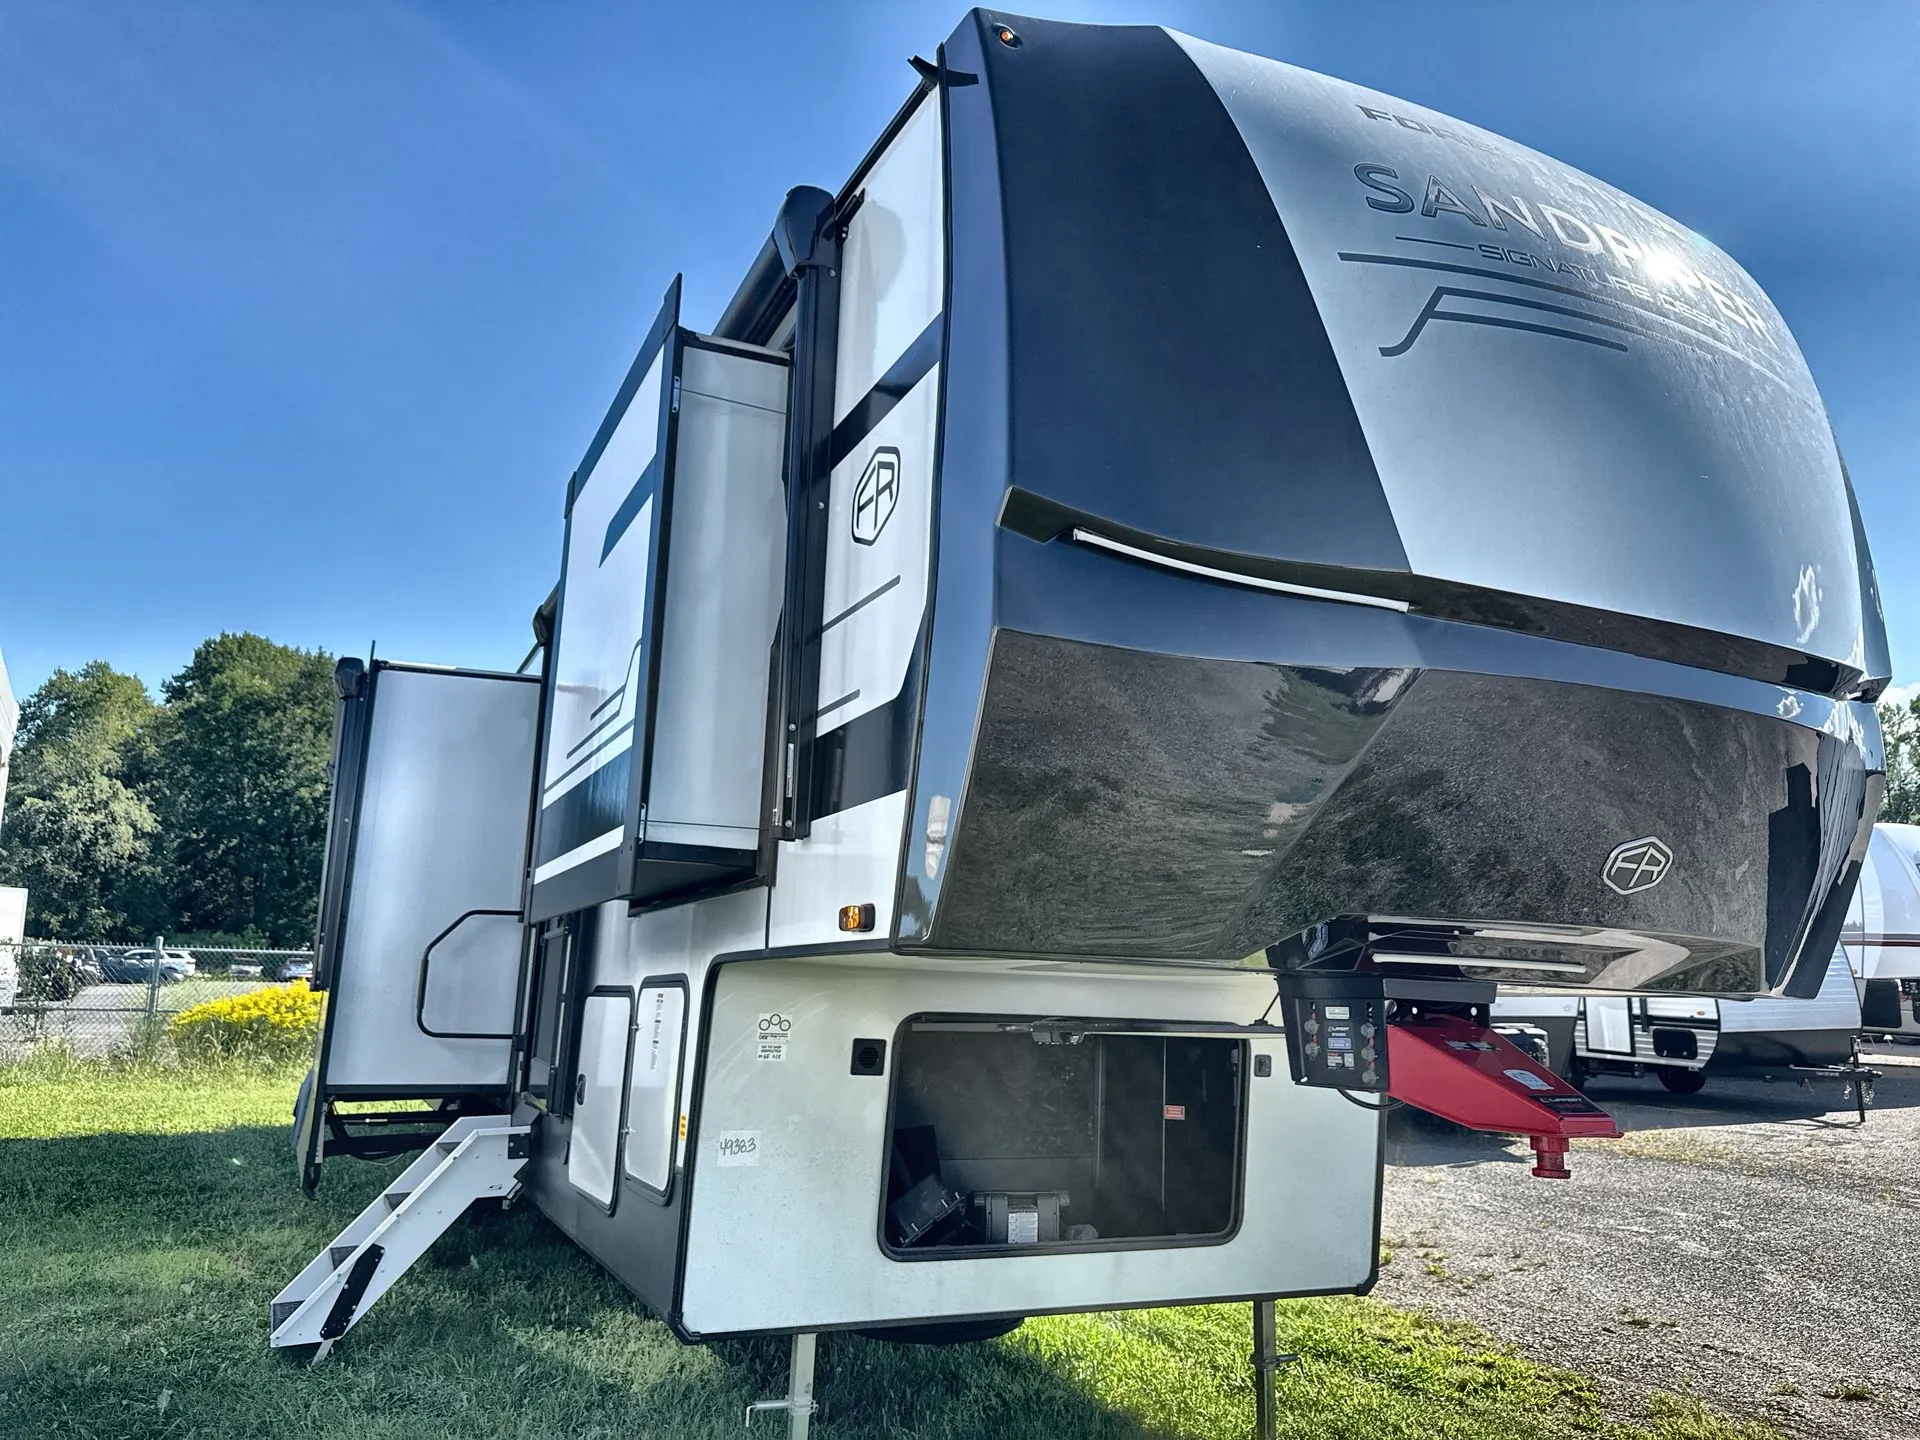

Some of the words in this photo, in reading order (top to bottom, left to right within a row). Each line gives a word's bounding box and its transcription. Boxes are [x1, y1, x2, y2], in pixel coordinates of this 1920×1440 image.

[1353, 162, 1781, 351] SANDPPER
[1478, 244, 1654, 303] SIGNATURE
[1657, 293, 1738, 340] DESIG
[719, 1137, 756, 1156] 49383
